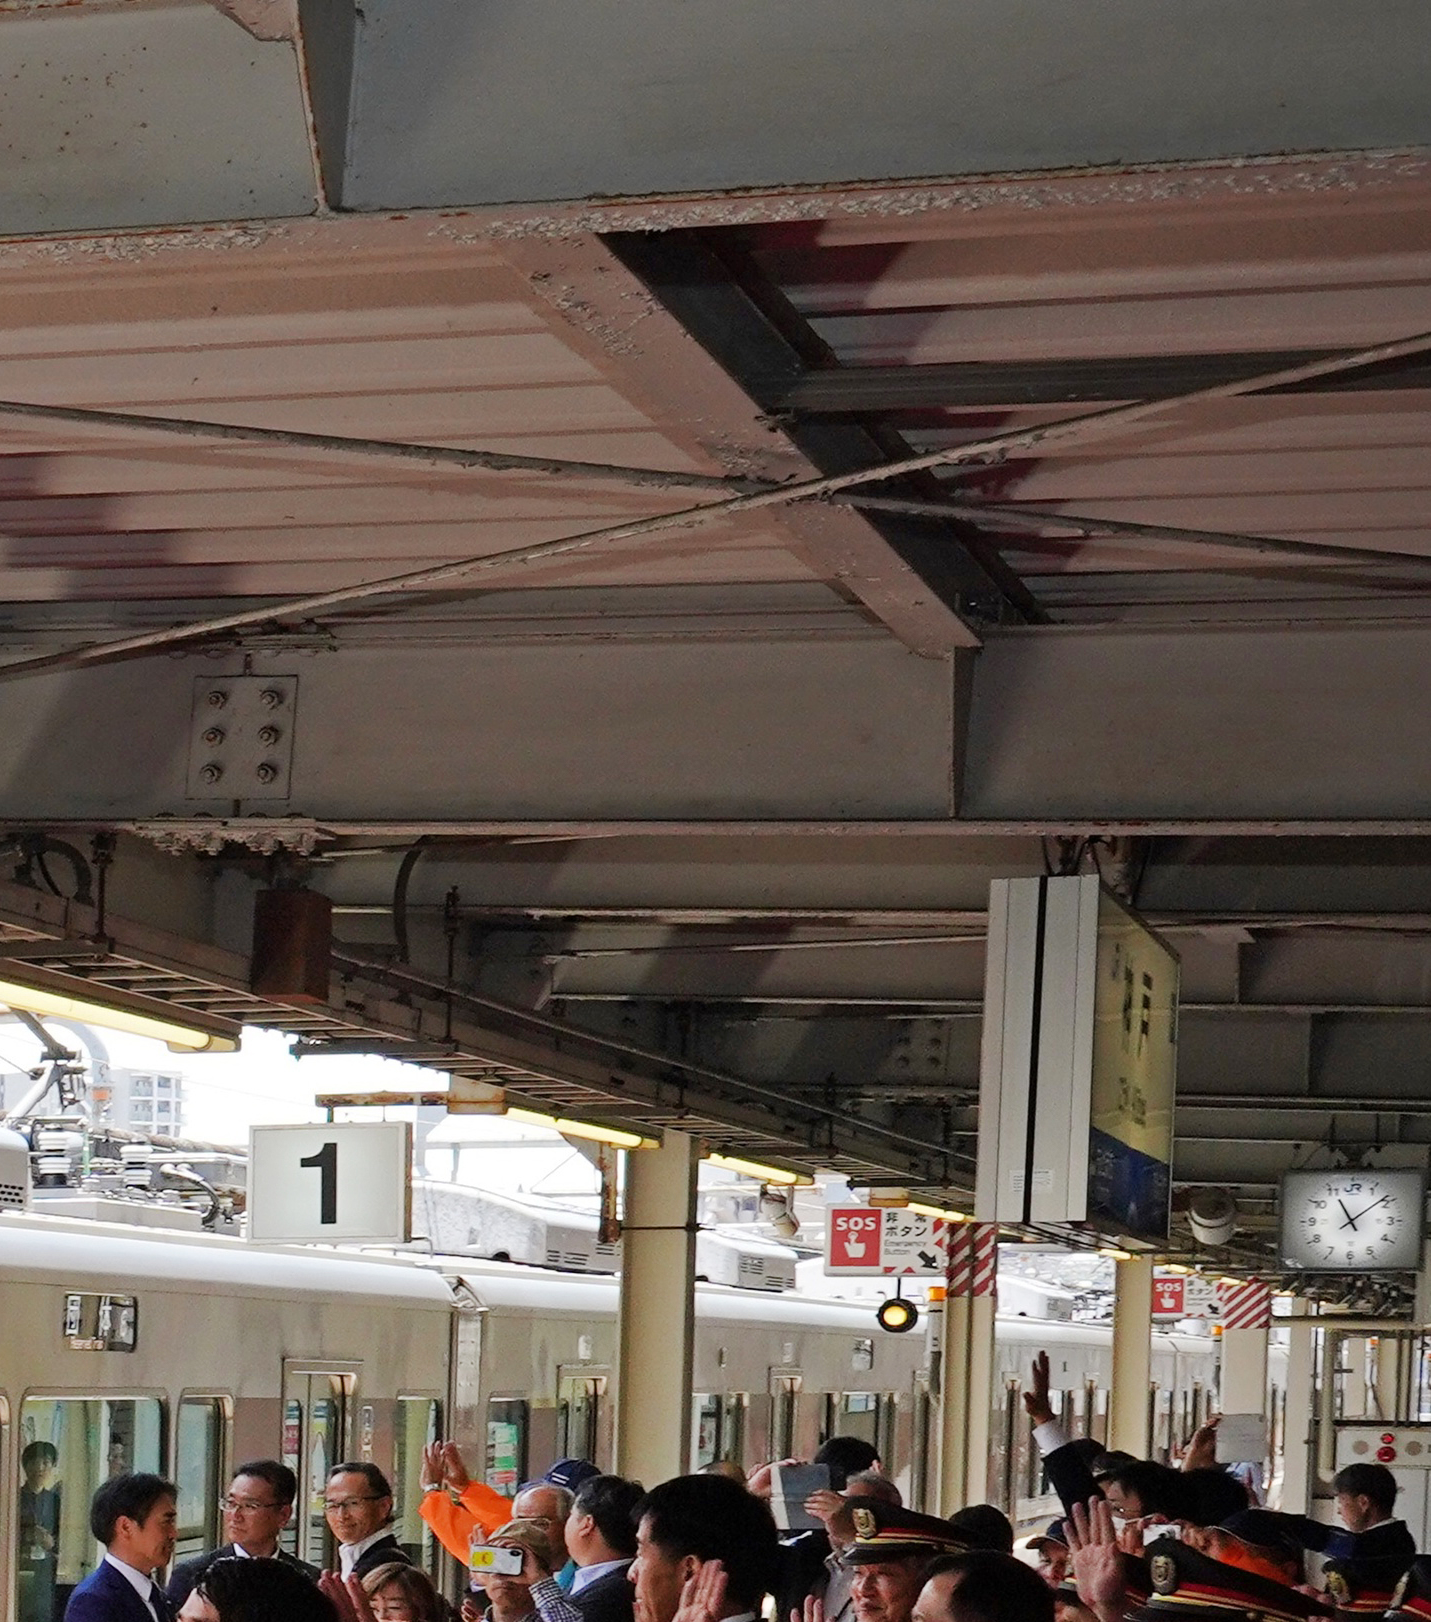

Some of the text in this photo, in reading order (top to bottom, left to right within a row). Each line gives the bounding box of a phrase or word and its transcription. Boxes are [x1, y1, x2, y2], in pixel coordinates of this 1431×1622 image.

[300, 1142, 337, 1224] 1
[1344, 1183, 1363, 1193] JR
[836, 1217, 877, 1231] SOS
[1155, 1283, 1182, 1292] SOS
